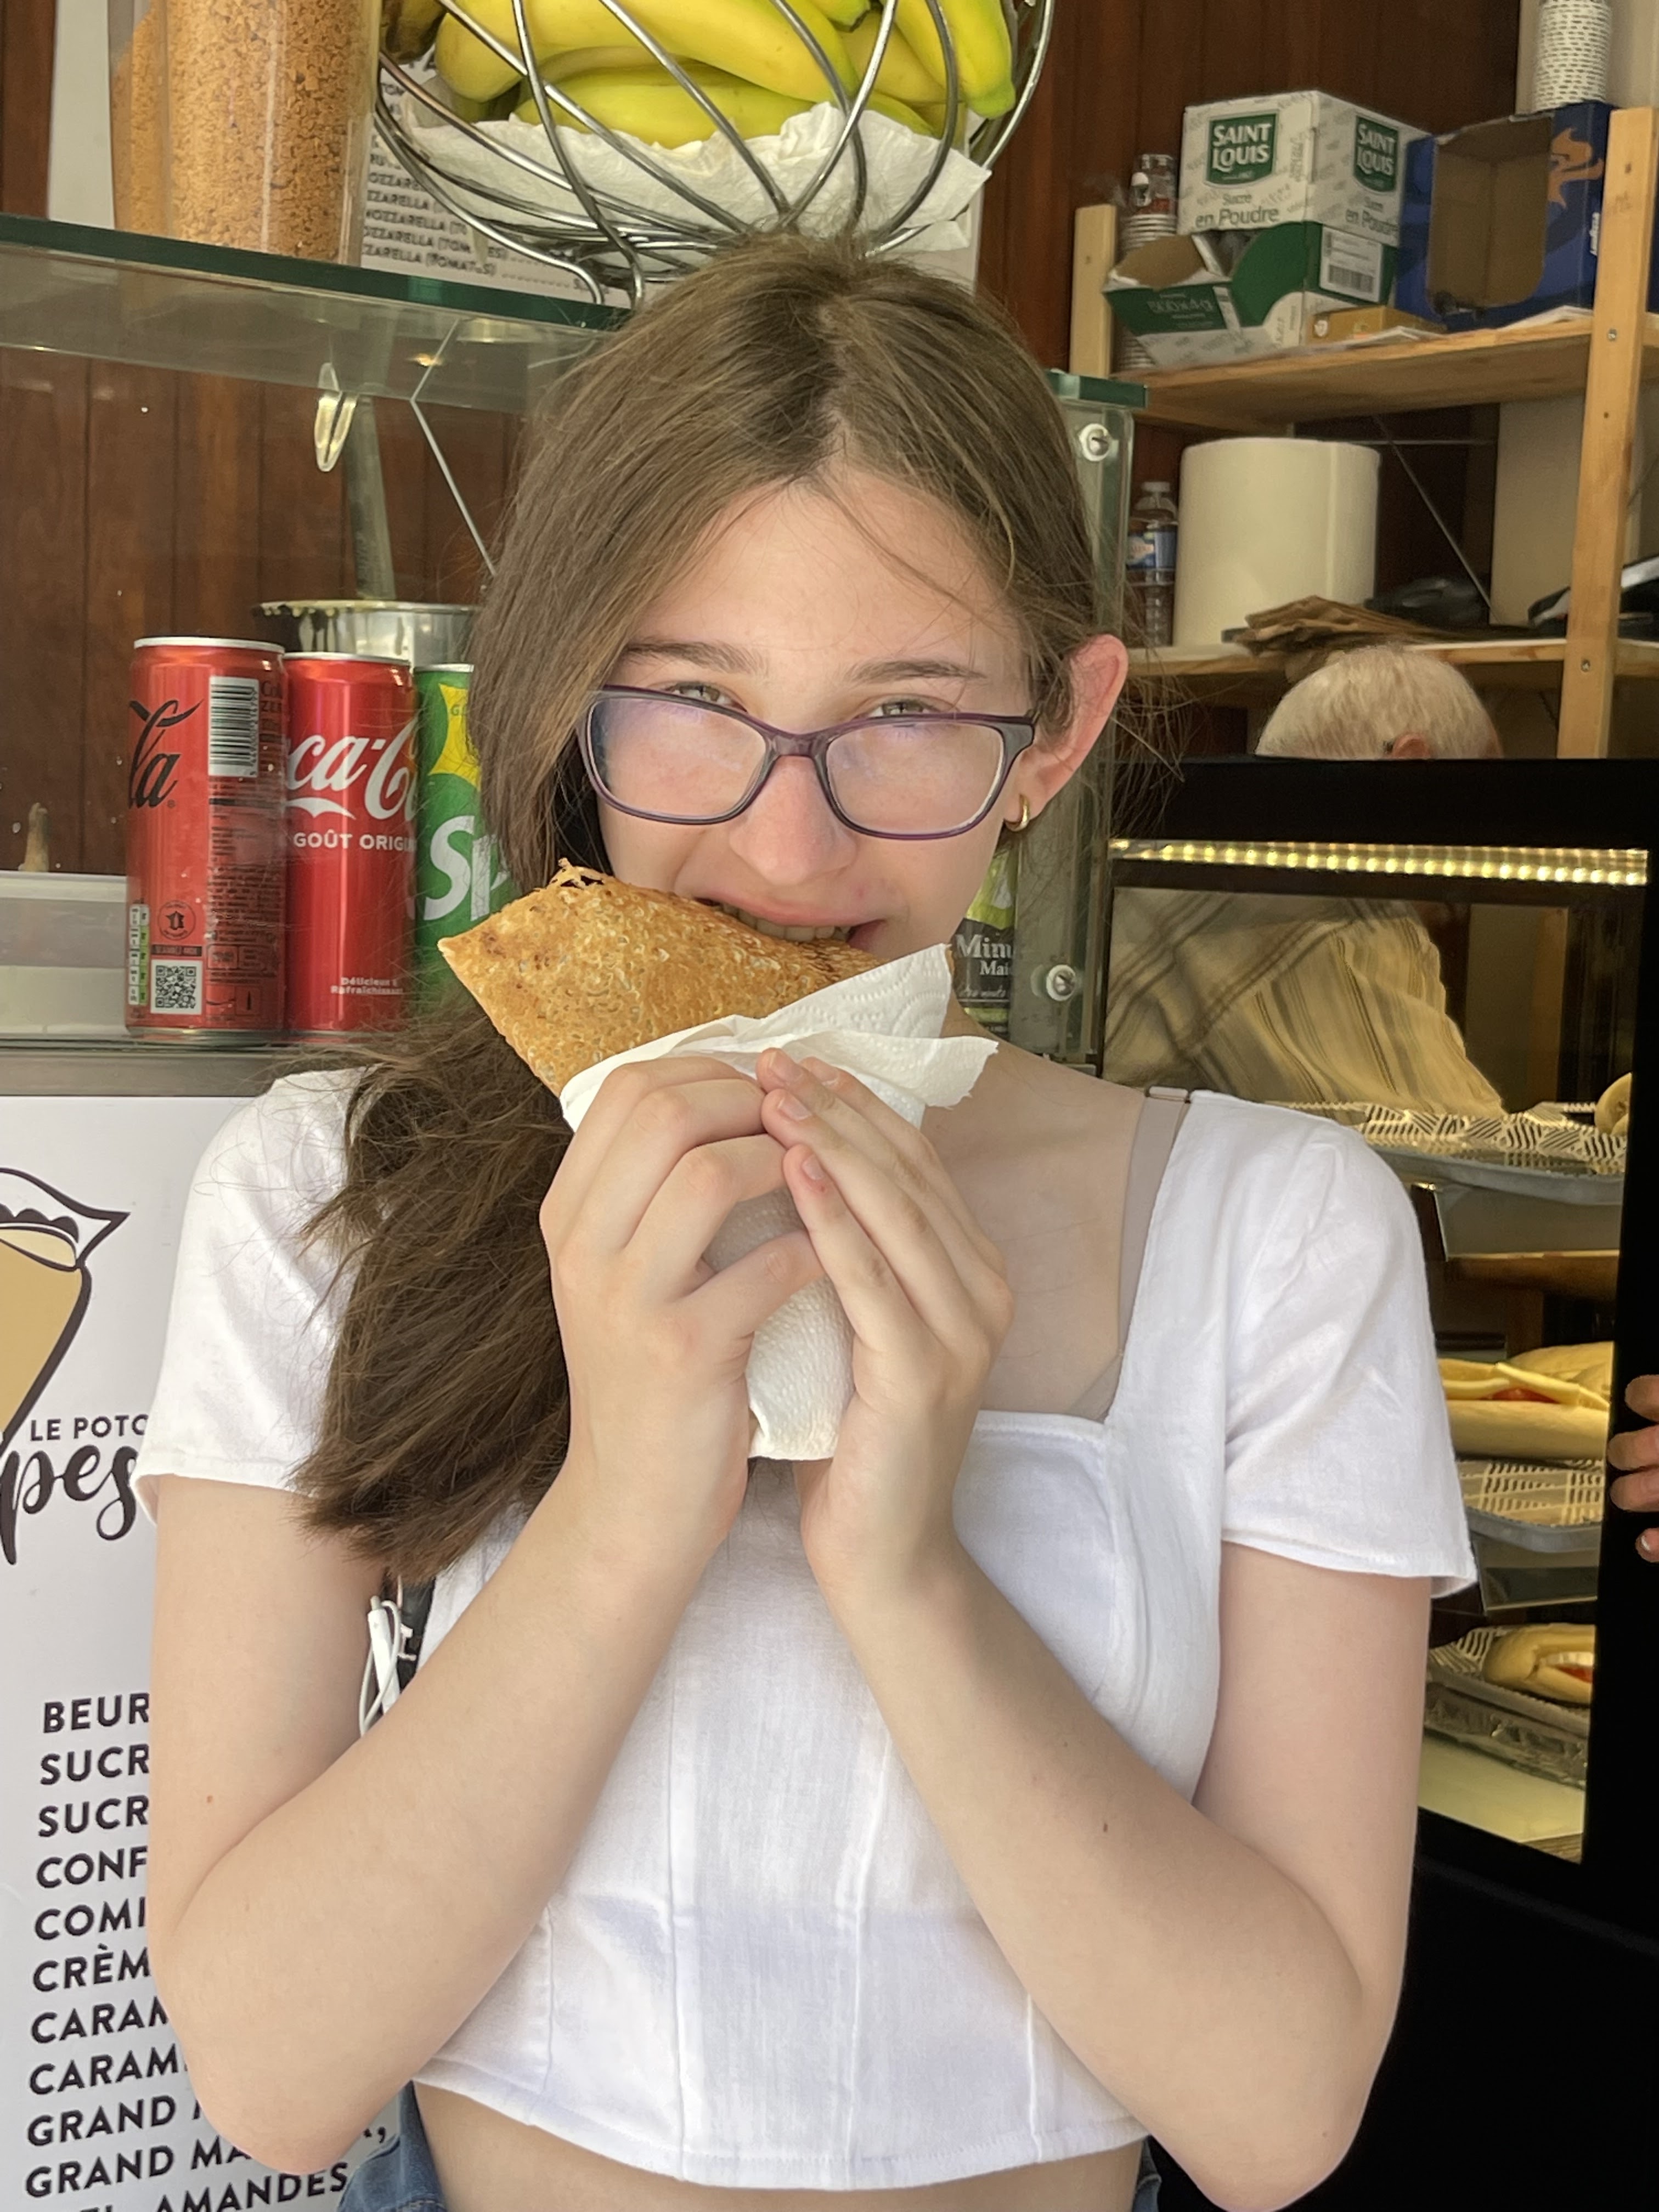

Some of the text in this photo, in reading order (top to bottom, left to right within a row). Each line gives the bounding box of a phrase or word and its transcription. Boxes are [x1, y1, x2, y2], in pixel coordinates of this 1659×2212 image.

[1213, 123, 1272, 146] SAINT
[1358, 123, 1396, 154] SAINT
[1212, 144, 1269, 172] LOUIS
[1357, 146, 1395, 176] LOUIS
[1195, 205, 1279, 228] en Poudre
[294, 829, 353, 849] GOÛT
[30, 1419, 61, 1442] LE
[43, 1692, 150, 1734] BEUR
[40, 1743, 150, 1785] SUCR
[38, 1795, 149, 1837] SUCR
[36, 1846, 148, 1888] CONF
[33, 1943, 151, 1993] CRÈM
[29, 2043, 187, 2095] CARAM
[27, 2095, 176, 2146] GRAND
[25, 2145, 174, 2198] GRAND
